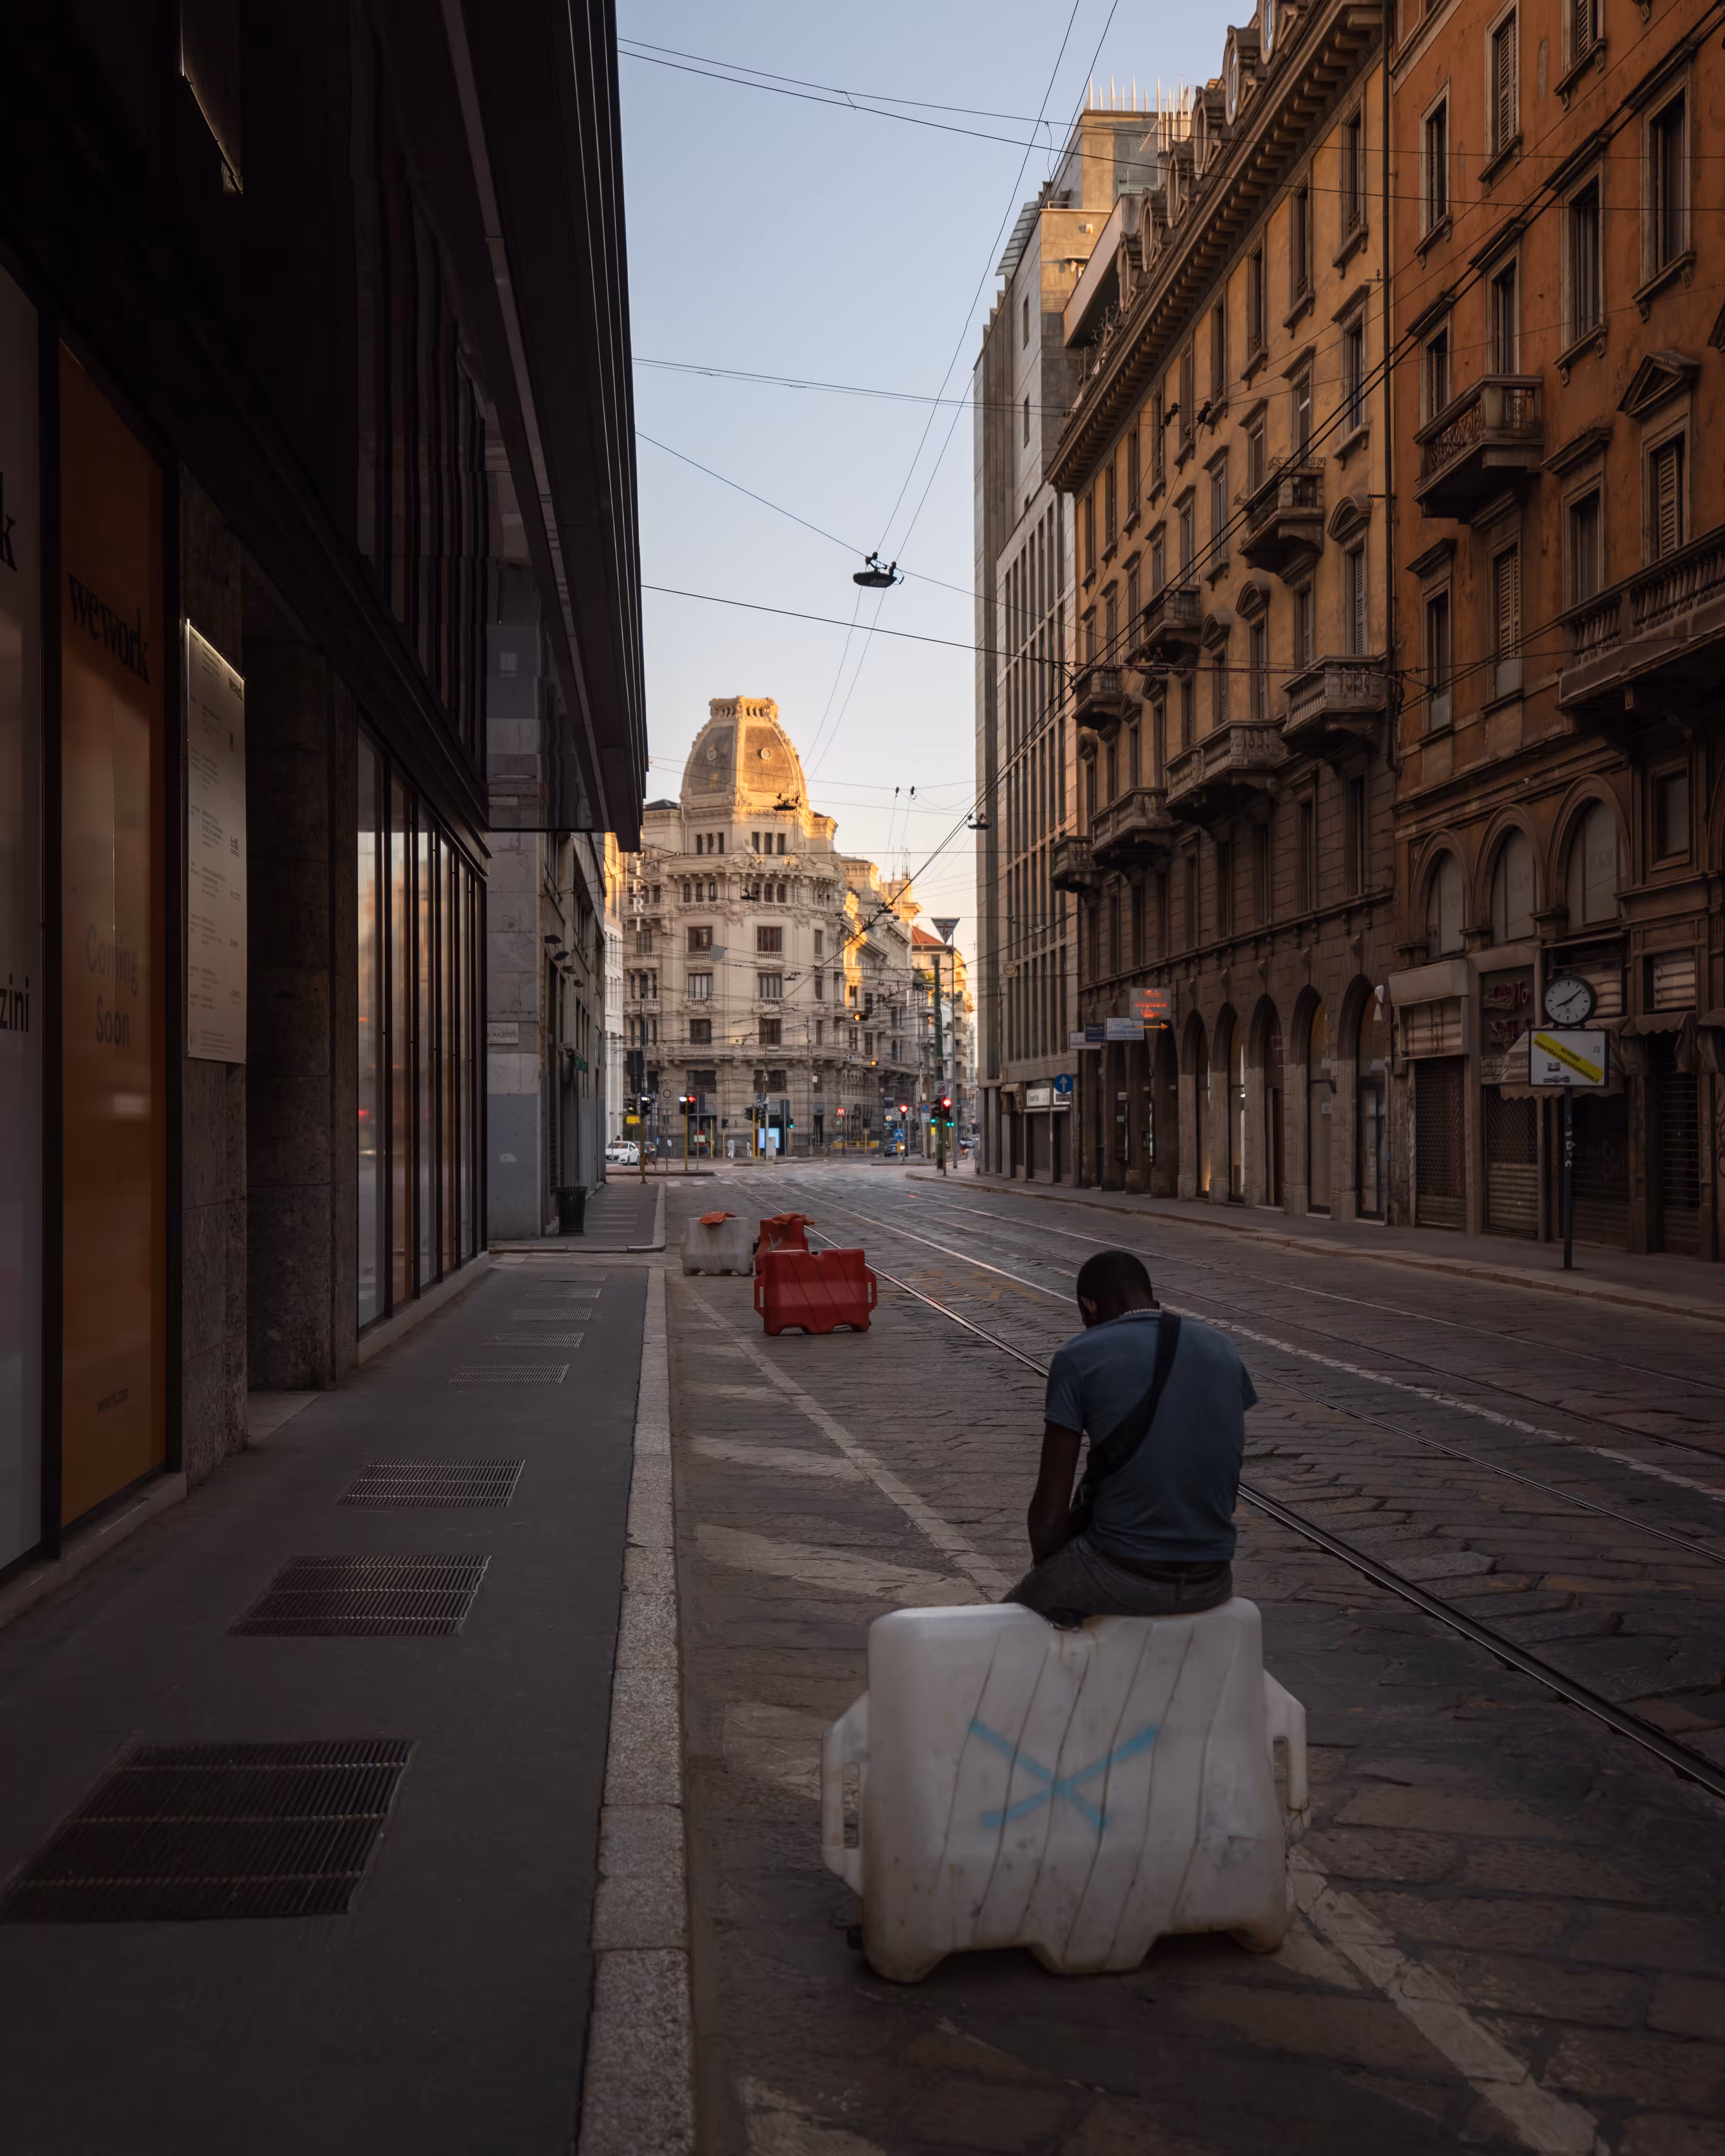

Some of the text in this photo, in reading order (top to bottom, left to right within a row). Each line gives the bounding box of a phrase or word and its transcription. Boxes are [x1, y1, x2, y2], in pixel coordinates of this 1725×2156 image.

[67, 572, 150, 684] wework
[86, 924, 138, 996] Coming
[96, 994, 130, 1048] Soon
